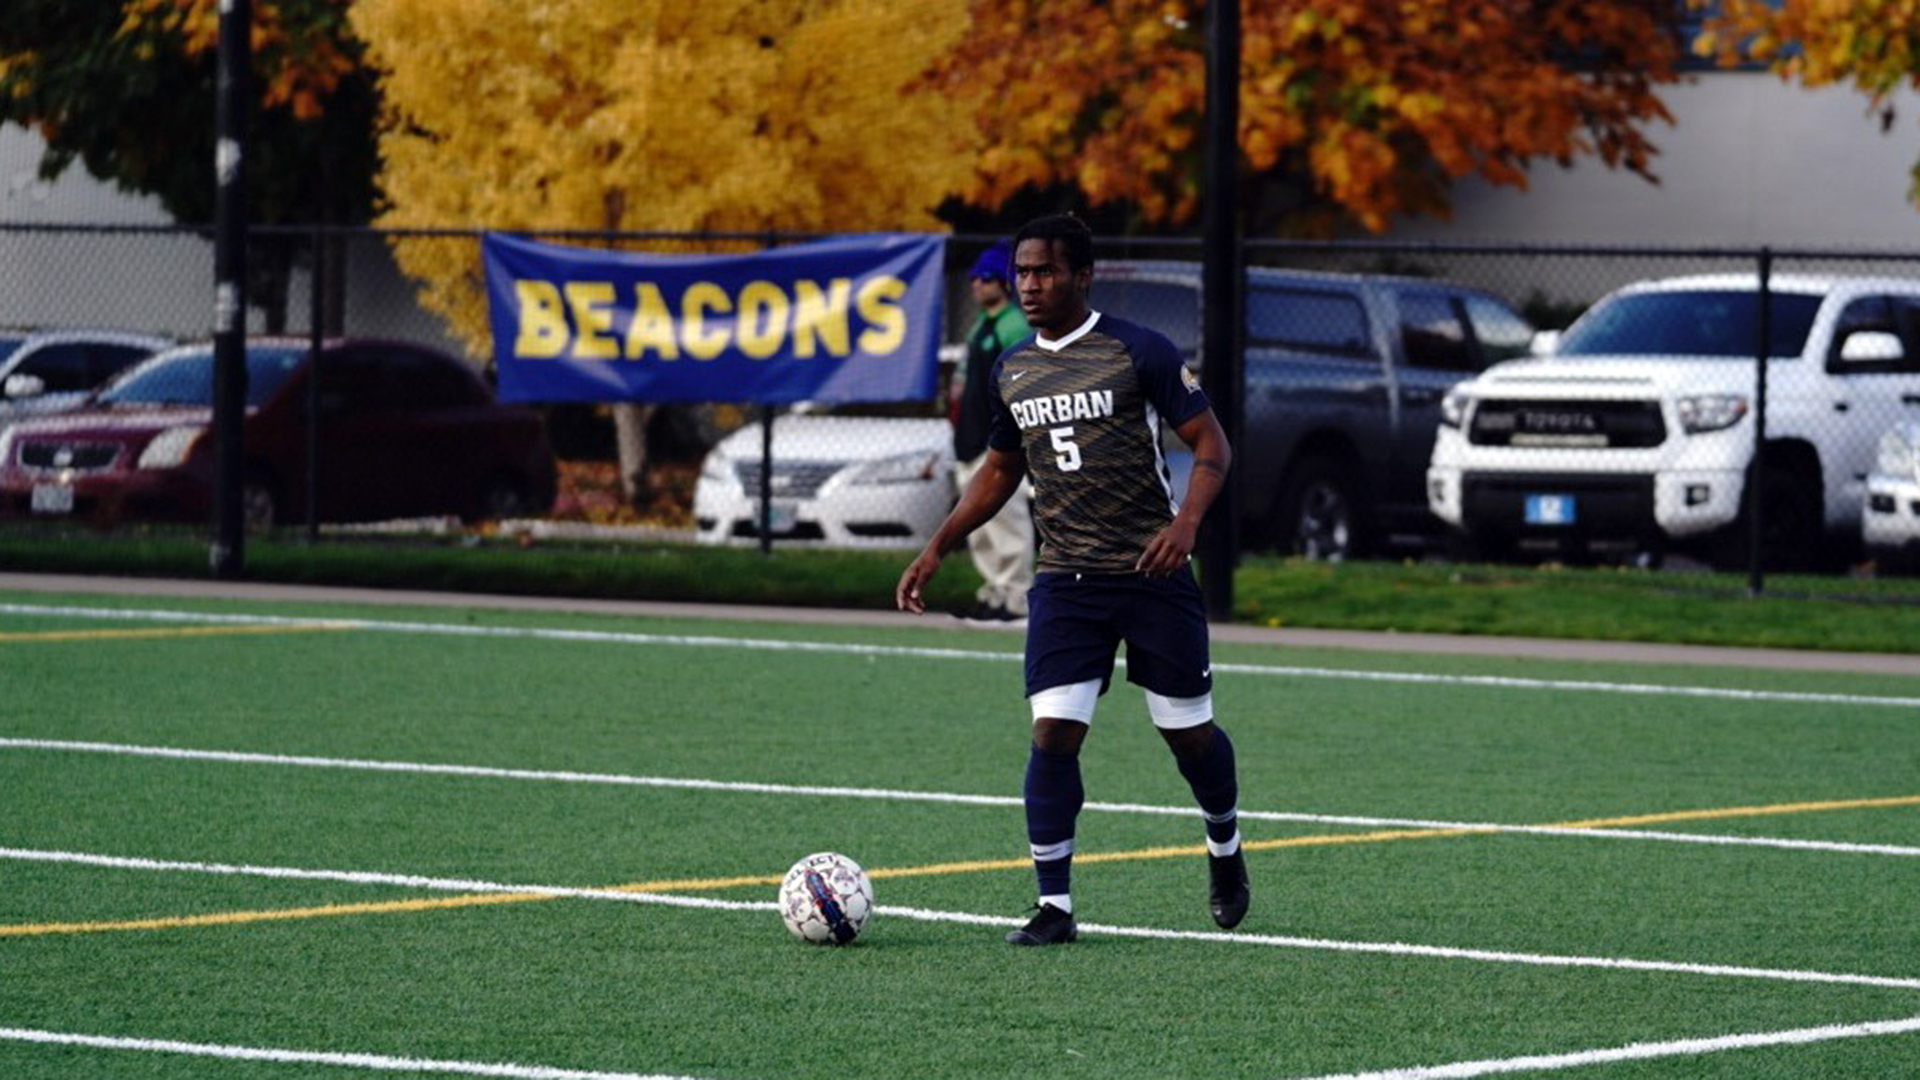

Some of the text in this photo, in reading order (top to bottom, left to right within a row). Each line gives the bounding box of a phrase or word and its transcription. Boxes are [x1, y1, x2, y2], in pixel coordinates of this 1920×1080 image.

[513, 277, 907, 360] BEACONS
[1011, 390, 1113, 430] CORBAN
[1049, 427, 1082, 472] 5
